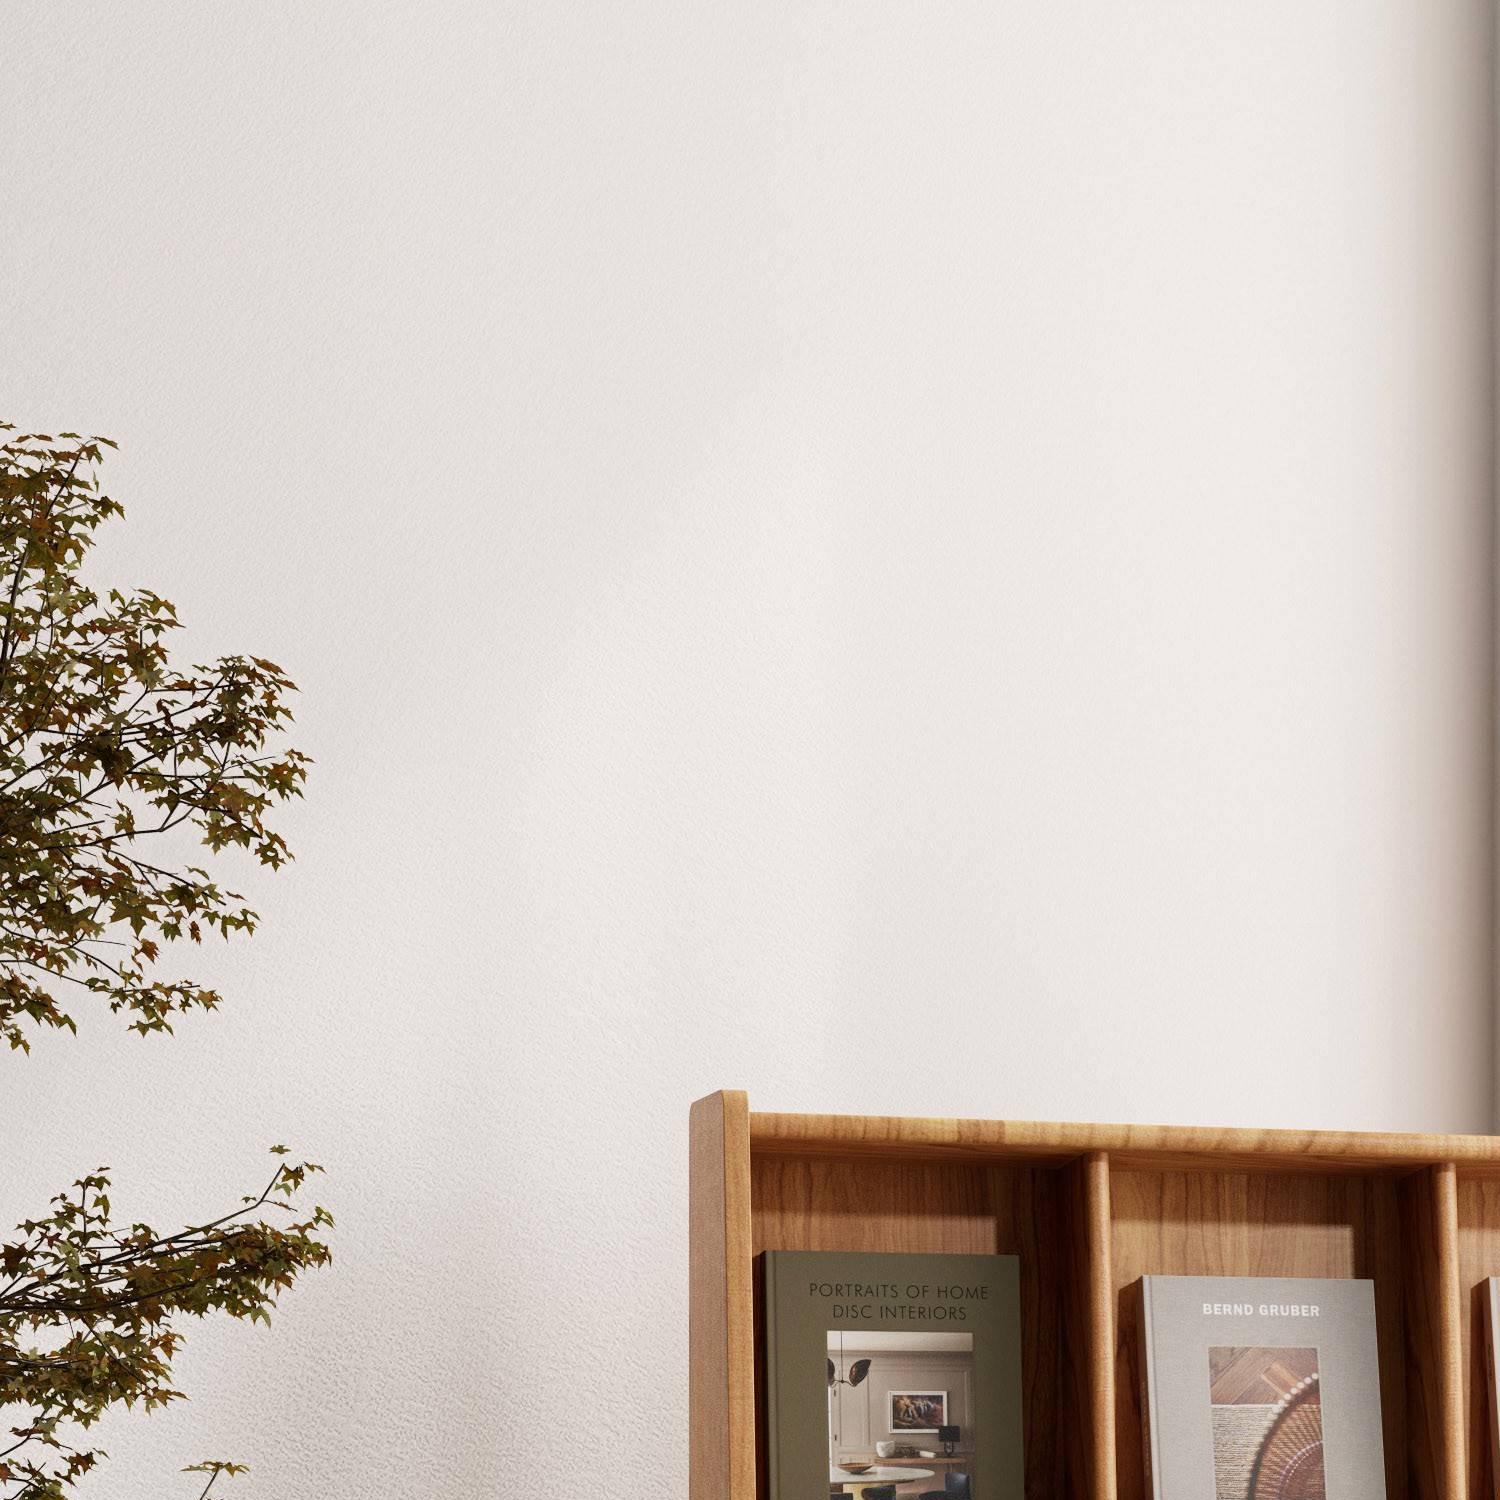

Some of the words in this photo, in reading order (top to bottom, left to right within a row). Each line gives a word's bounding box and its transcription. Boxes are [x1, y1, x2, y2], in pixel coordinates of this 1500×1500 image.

[809, 1282, 899, 1298] PORTRAITS
[905, 1284, 929, 1299] OF
[937, 1285, 989, 1300] HOME
[832, 1304, 873, 1319] DISC
[879, 1305, 967, 1321] INTERIORS
[1202, 1303, 1254, 1316] BERND
[1258, 1303, 1320, 1317] GRUBER
